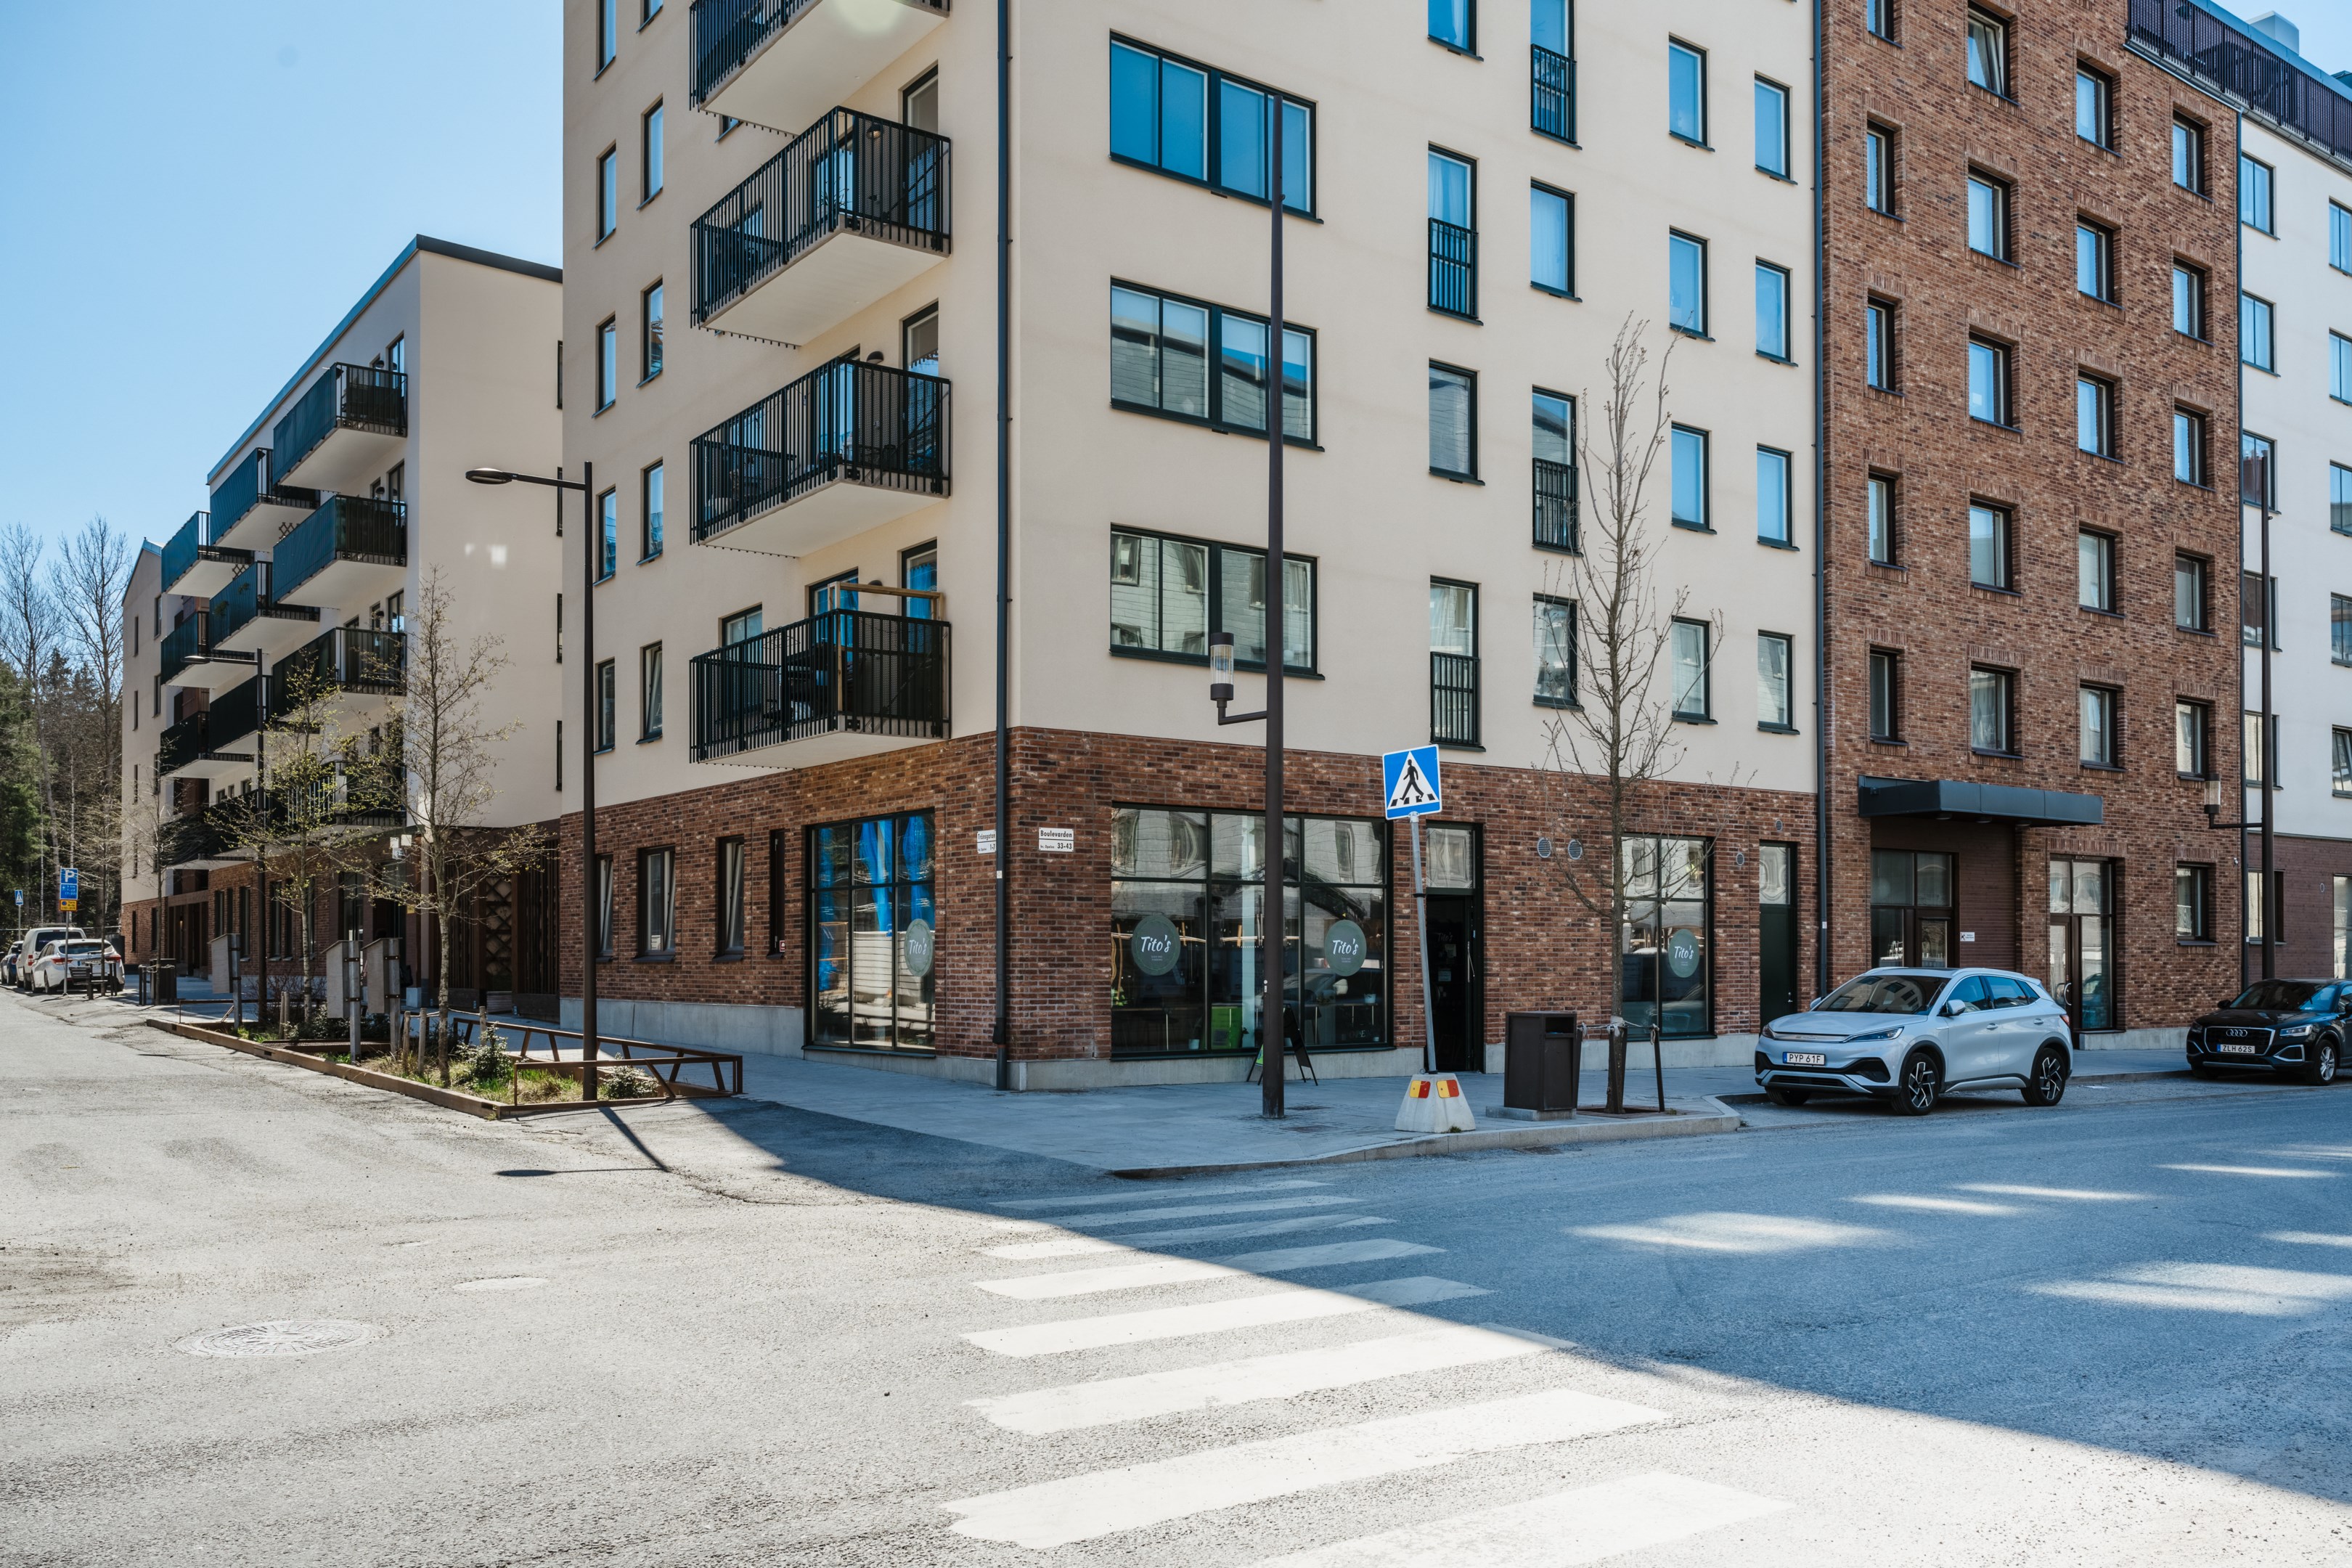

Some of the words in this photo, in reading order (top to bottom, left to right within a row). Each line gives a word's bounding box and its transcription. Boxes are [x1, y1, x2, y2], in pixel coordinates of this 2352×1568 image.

[65, 870, 75, 883] P
[909, 937, 928, 955] Tito's
[1141, 934, 1172, 952] Tito's
[1333, 938, 1359, 955] Tito's
[1674, 944, 1694, 960] Tito's
[1789, 1053, 1804, 1062] PYP
[1805, 1055, 1821, 1063] 61F
